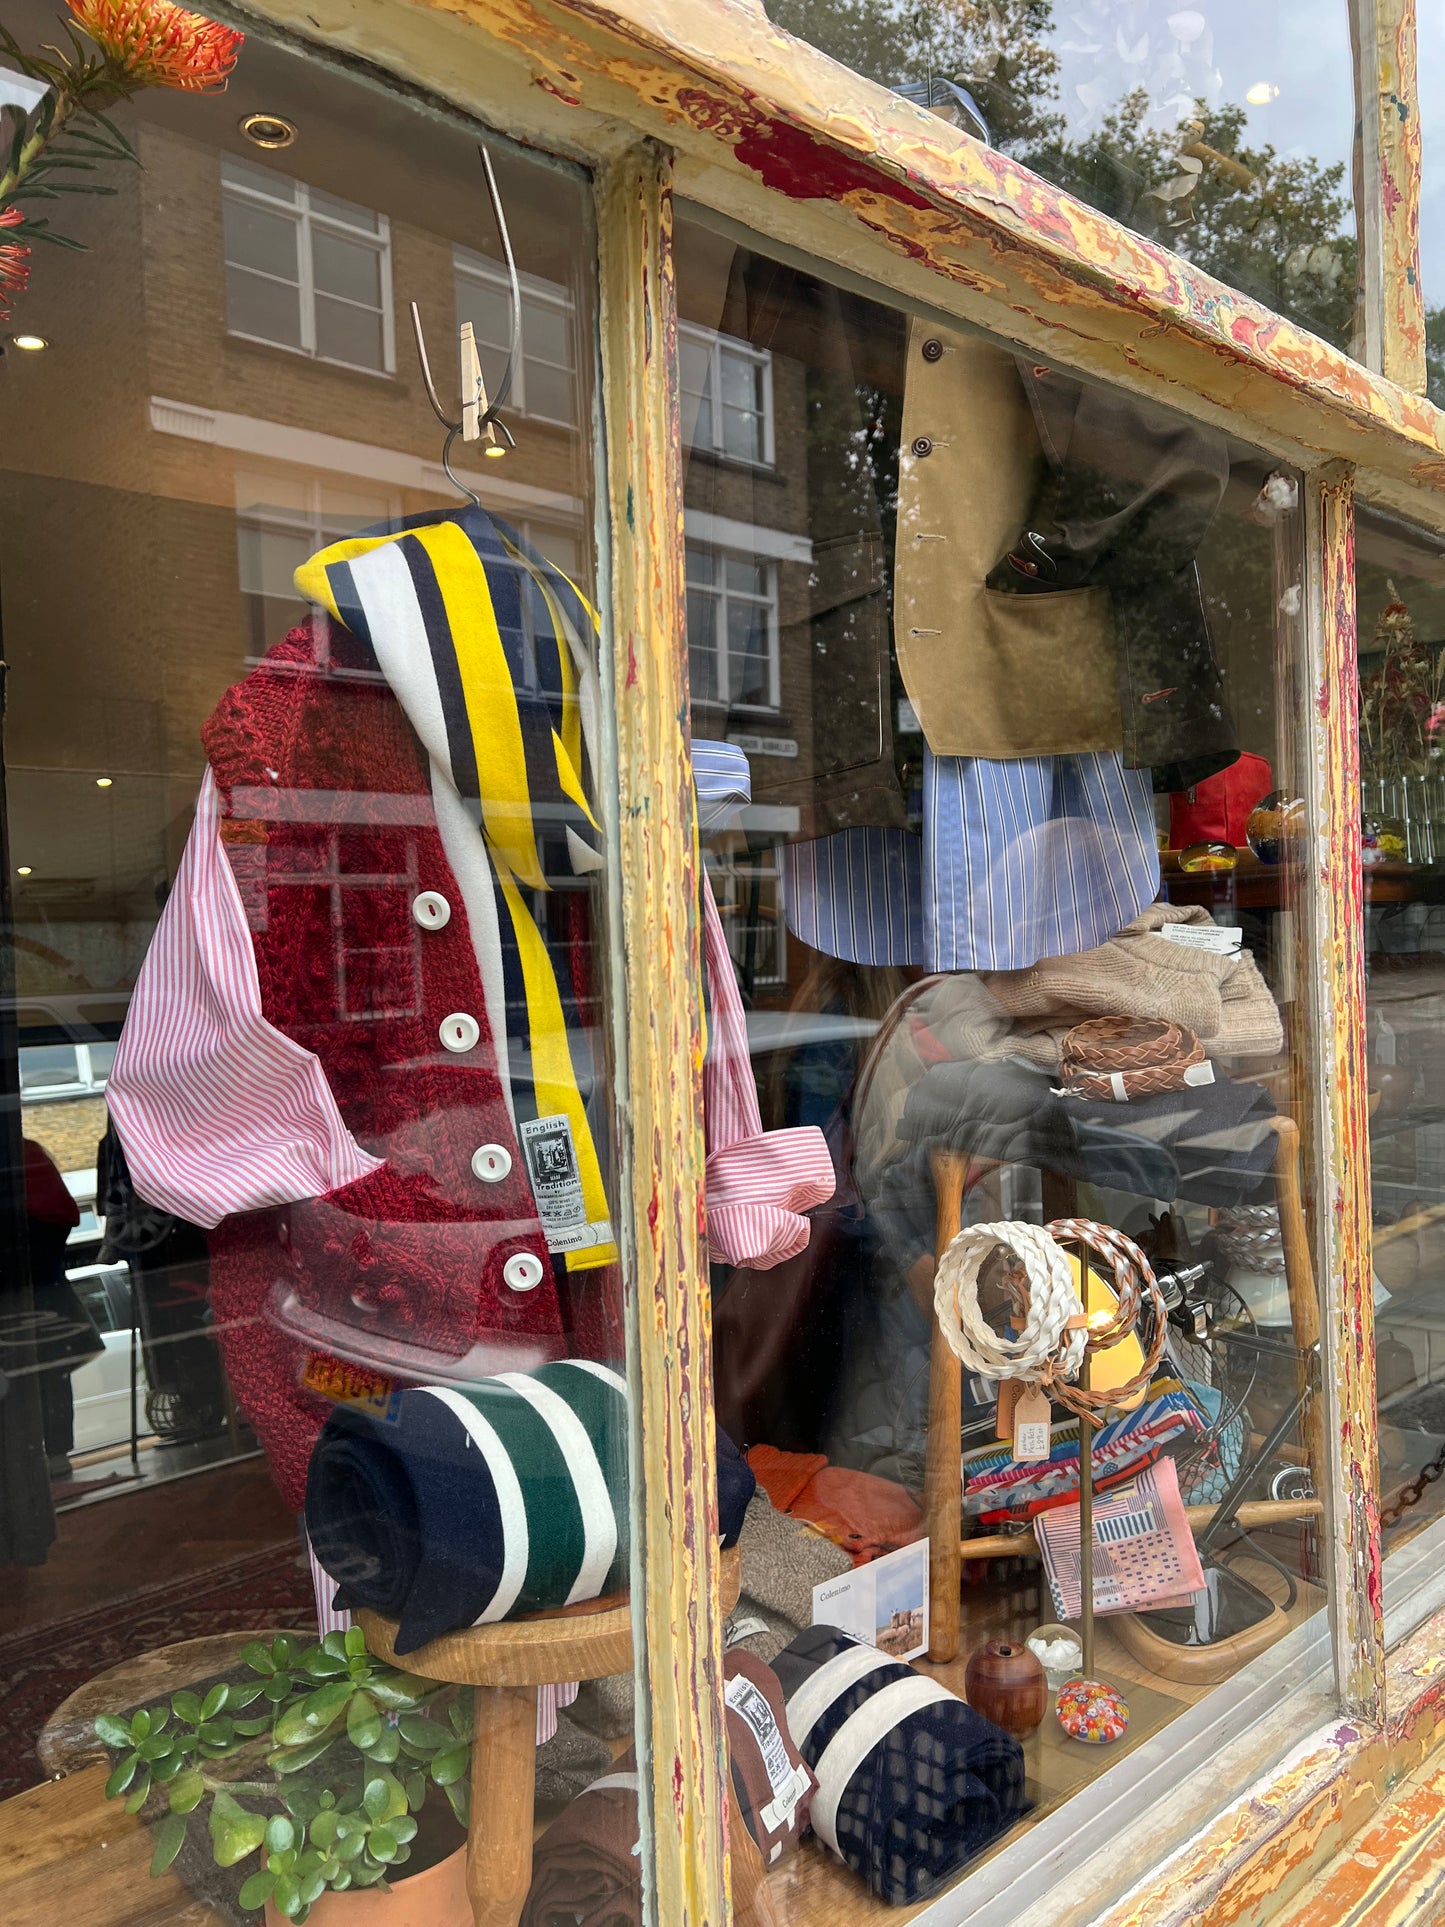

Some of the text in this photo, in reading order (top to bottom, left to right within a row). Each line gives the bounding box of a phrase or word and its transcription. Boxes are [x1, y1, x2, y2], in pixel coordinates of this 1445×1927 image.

[525, 1121, 565, 1134] English
[536, 1179, 577, 1191] Tradition
[546, 1235, 583, 1247] Colenimo
[820, 1584, 851, 1602] Colenimo
[729, 1682, 750, 1704] English
